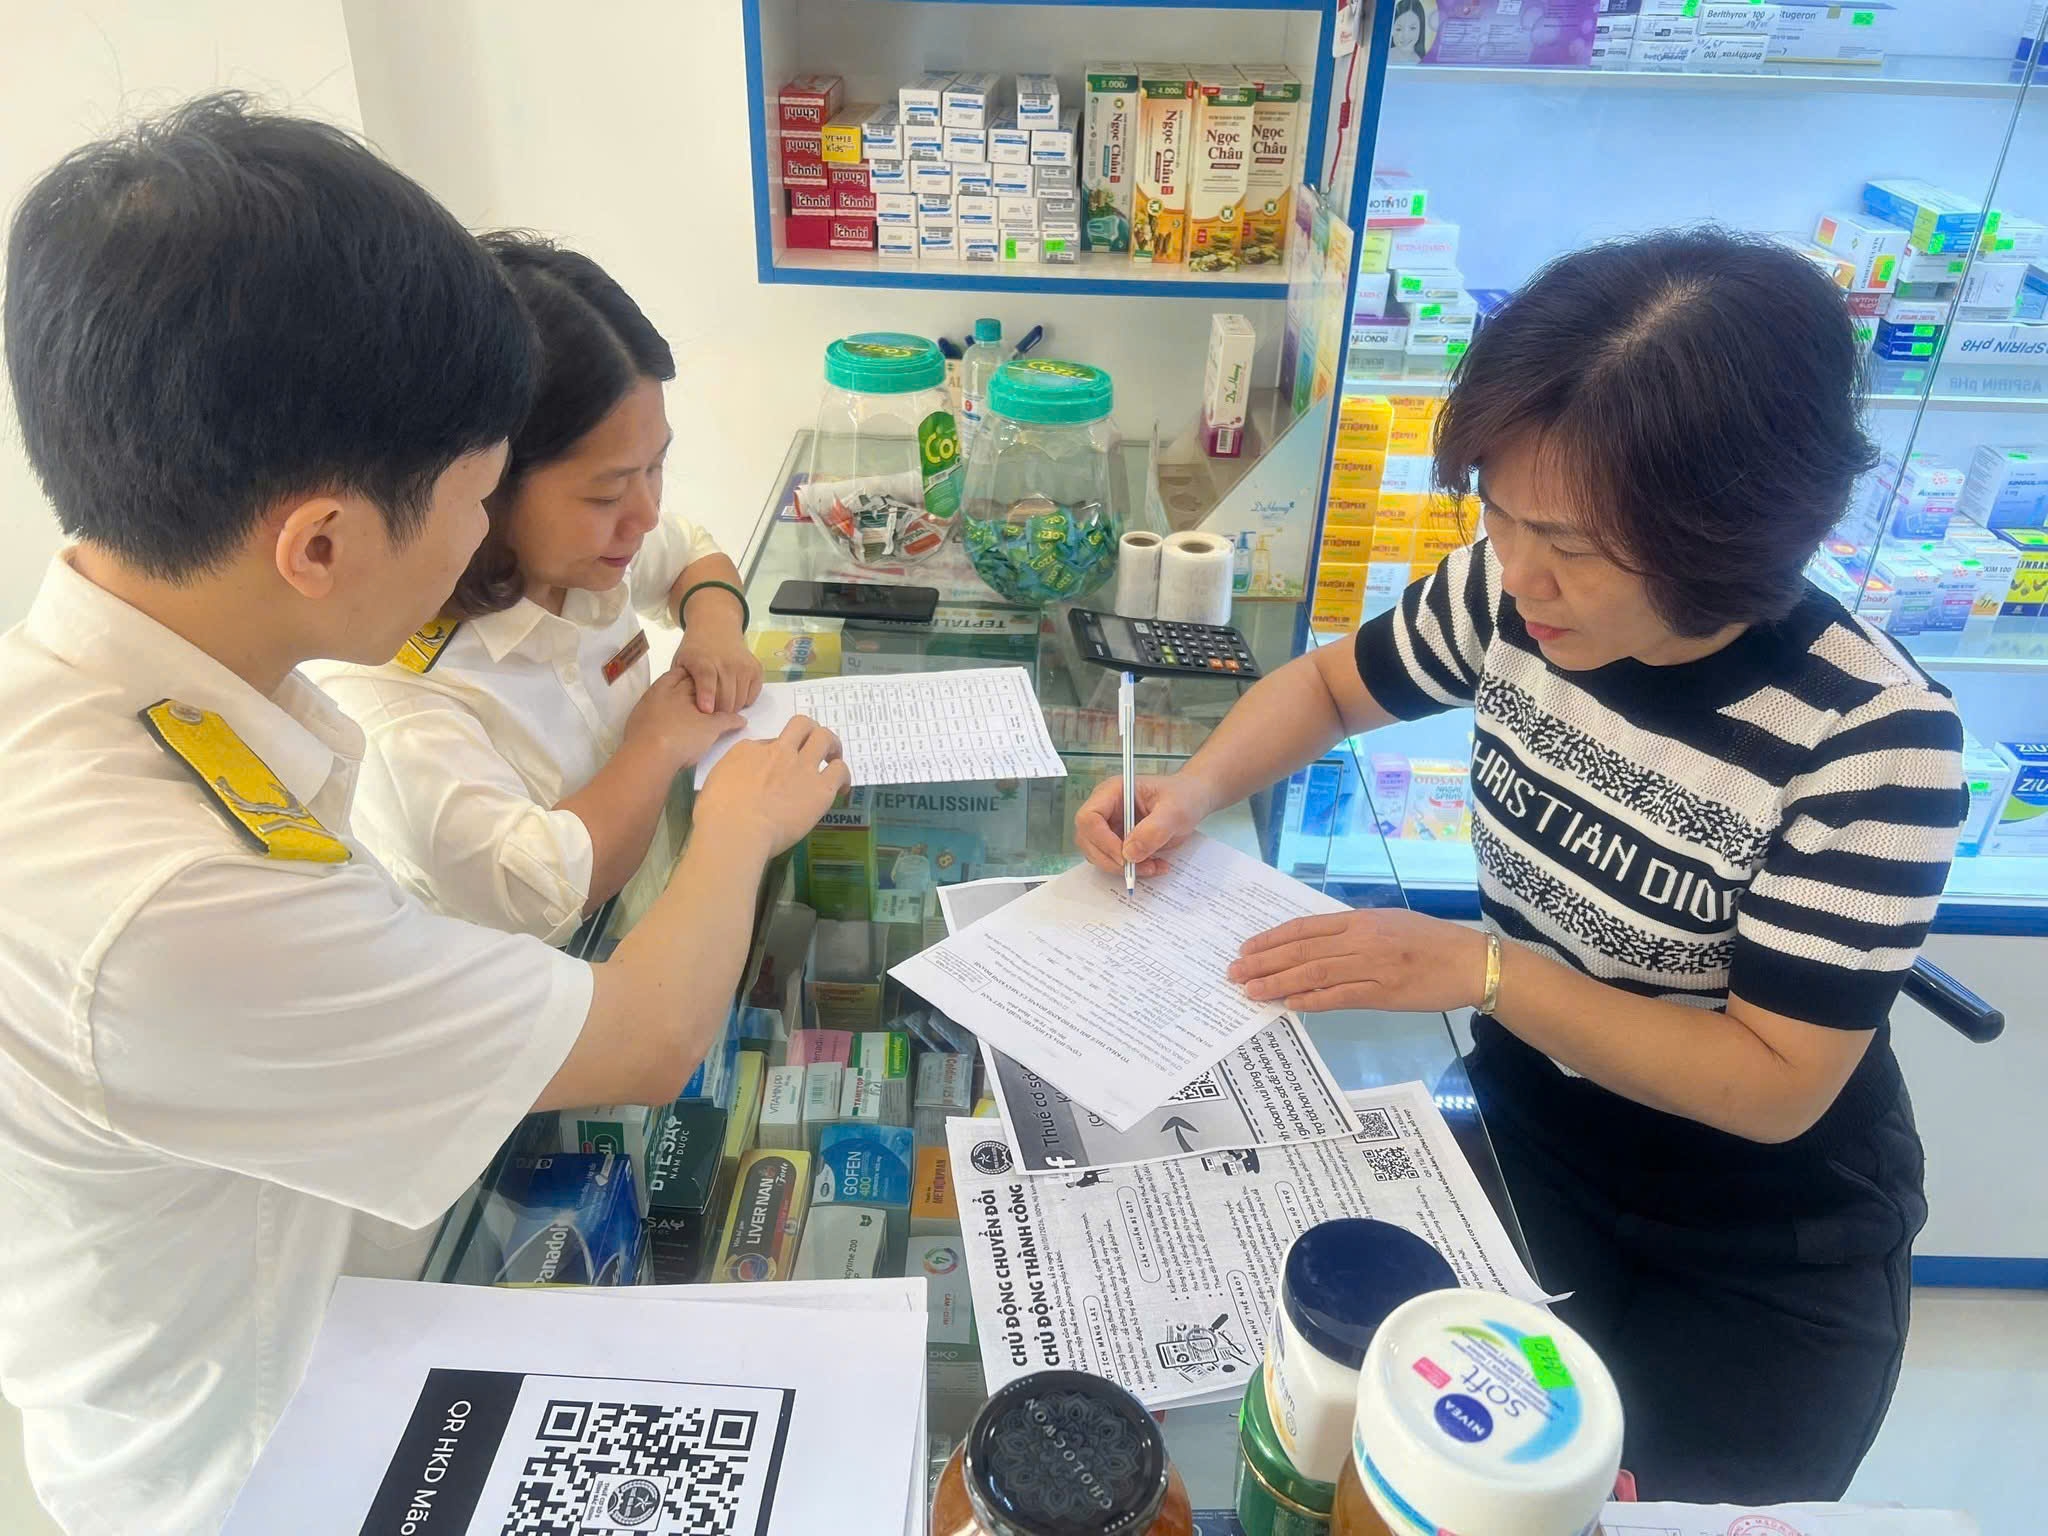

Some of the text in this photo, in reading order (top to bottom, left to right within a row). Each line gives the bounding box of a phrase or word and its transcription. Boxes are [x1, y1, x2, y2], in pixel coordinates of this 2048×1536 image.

[1779, 9, 1816, 20] tugeron
[1206, 130, 1240, 146] Ngọc
[1253, 141, 1287, 155] Châu
[1208, 146, 1243, 160] Châu
[1961, 339, 2048, 354] SPIRIN pH8
[925, 434, 961, 464] Co
[875, 792, 999, 812] TEPTALISSINE
[1471, 739, 1638, 881] HRISTIAN
[817, 814, 861, 825] ROSPAN
[1262, 1031, 1279, 1049] thuế
[1258, 1053, 1275, 1074] nhận
[1274, 1049, 1292, 1069] quan
[1265, 1075, 1281, 1085] để
[1283, 1070, 1297, 1082] Cơ
[1237, 1051, 1285, 1129] doanh vui lòng Quét
[1274, 1085, 1289, 1098] sát
[1290, 1082, 1302, 1091] từ
[1035, 1089, 1049, 1111] cơ
[1283, 1099, 1300, 1121] khảo
[1297, 1092, 1312, 1109] hơn
[1305, 1109, 1318, 1121] tốt
[1039, 1112, 1060, 1147] Thuế
[843, 1152, 862, 1196] GOFEN
[859, 1177, 872, 1196] 400
[972, 1189, 998, 1216] ĐỔI
[978, 1218, 1010, 1278] CHUYỂN
[1008, 1184, 1060, 1366] CHỦ ĐỘNG THÀNH CÔNG
[996, 1281, 1022, 1328] ĐỘNG
[1002, 1332, 1027, 1366] CHỦ
[443, 1400, 472, 1432] QR
[1443, 1402, 1485, 1436] NIVEA
[423, 1436, 460, 1484] HKD
